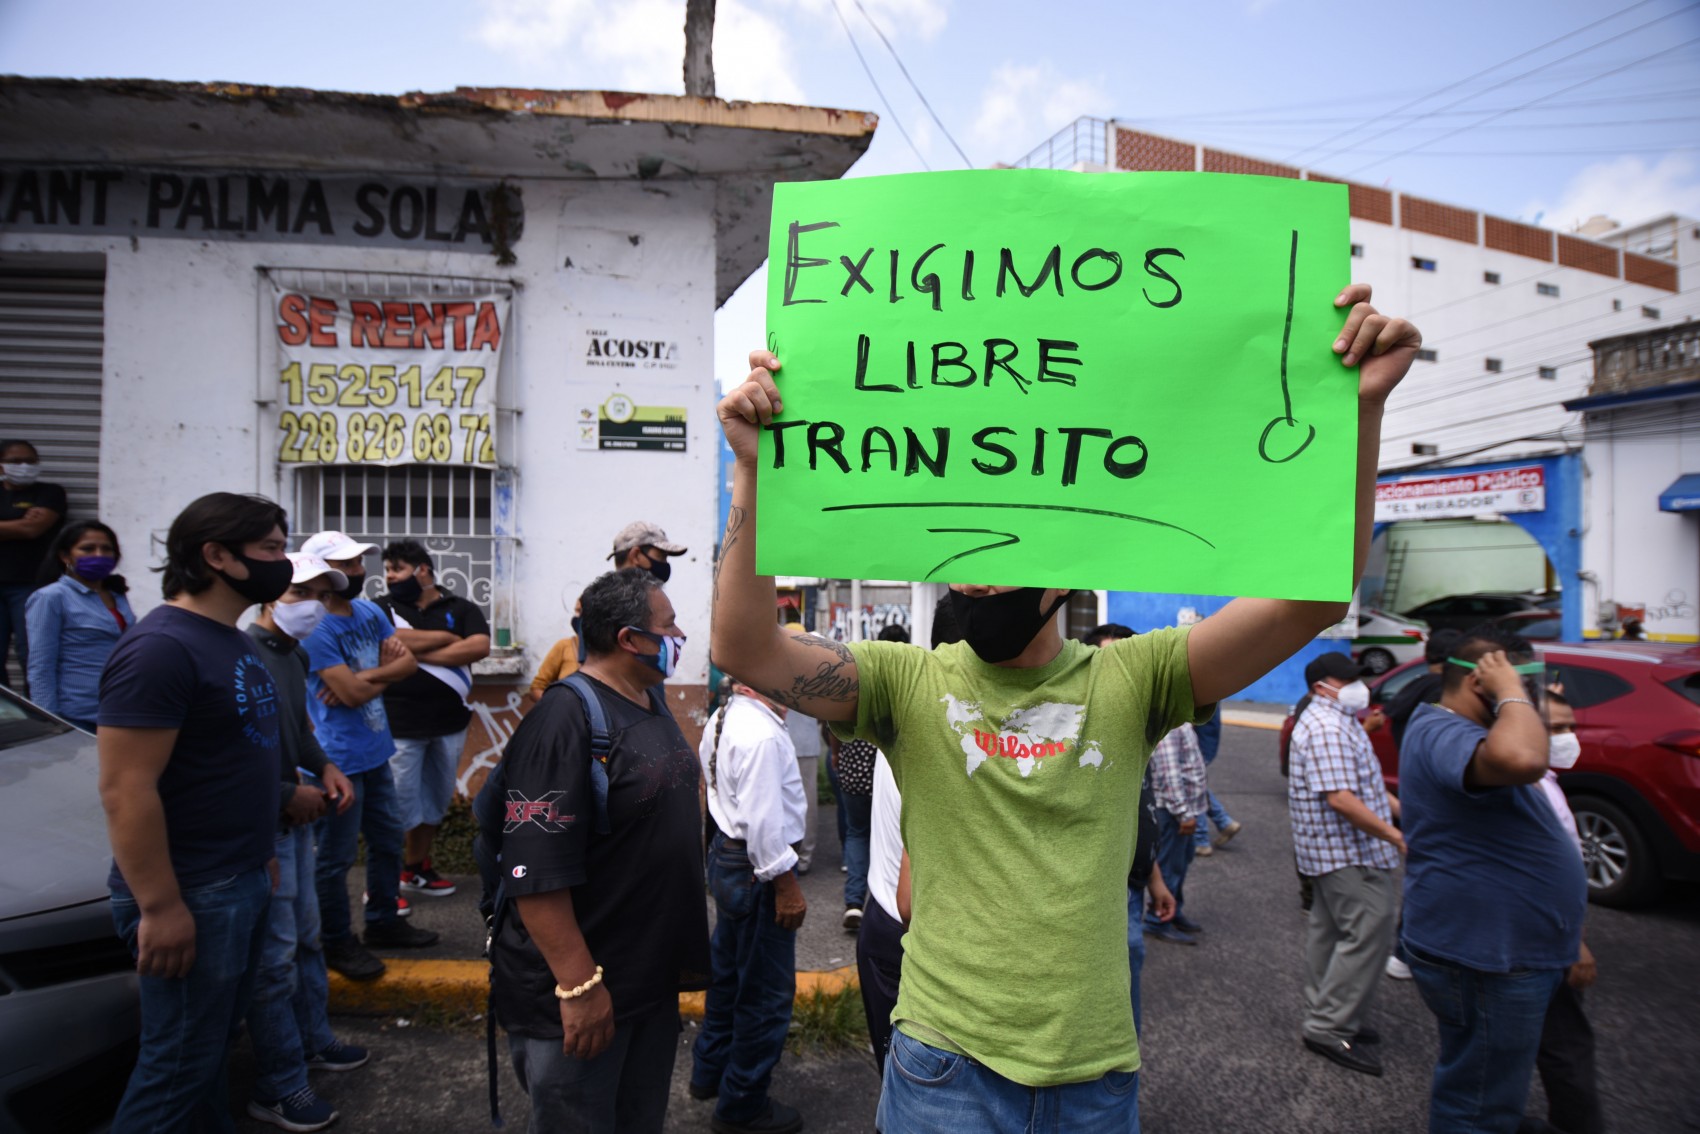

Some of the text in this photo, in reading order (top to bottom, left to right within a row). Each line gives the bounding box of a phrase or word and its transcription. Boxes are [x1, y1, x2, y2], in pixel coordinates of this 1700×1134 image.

[0, 170, 494, 245] ANT PALMA SOLA
[783, 220, 1187, 310] EXIGIMOS
[278, 294, 501, 351] SE RENTA
[280, 362, 486, 408] 1525147
[855, 333, 1084, 395] LIBRE
[279, 411, 497, 464] 228 826 68 72
[763, 419, 1149, 487] TRANSITO
[1476, 470, 1540, 491] Público
[234, 657, 249, 716] TOMMY
[973, 728, 1068, 758] Wilson
[505, 801, 576, 822] XFL
